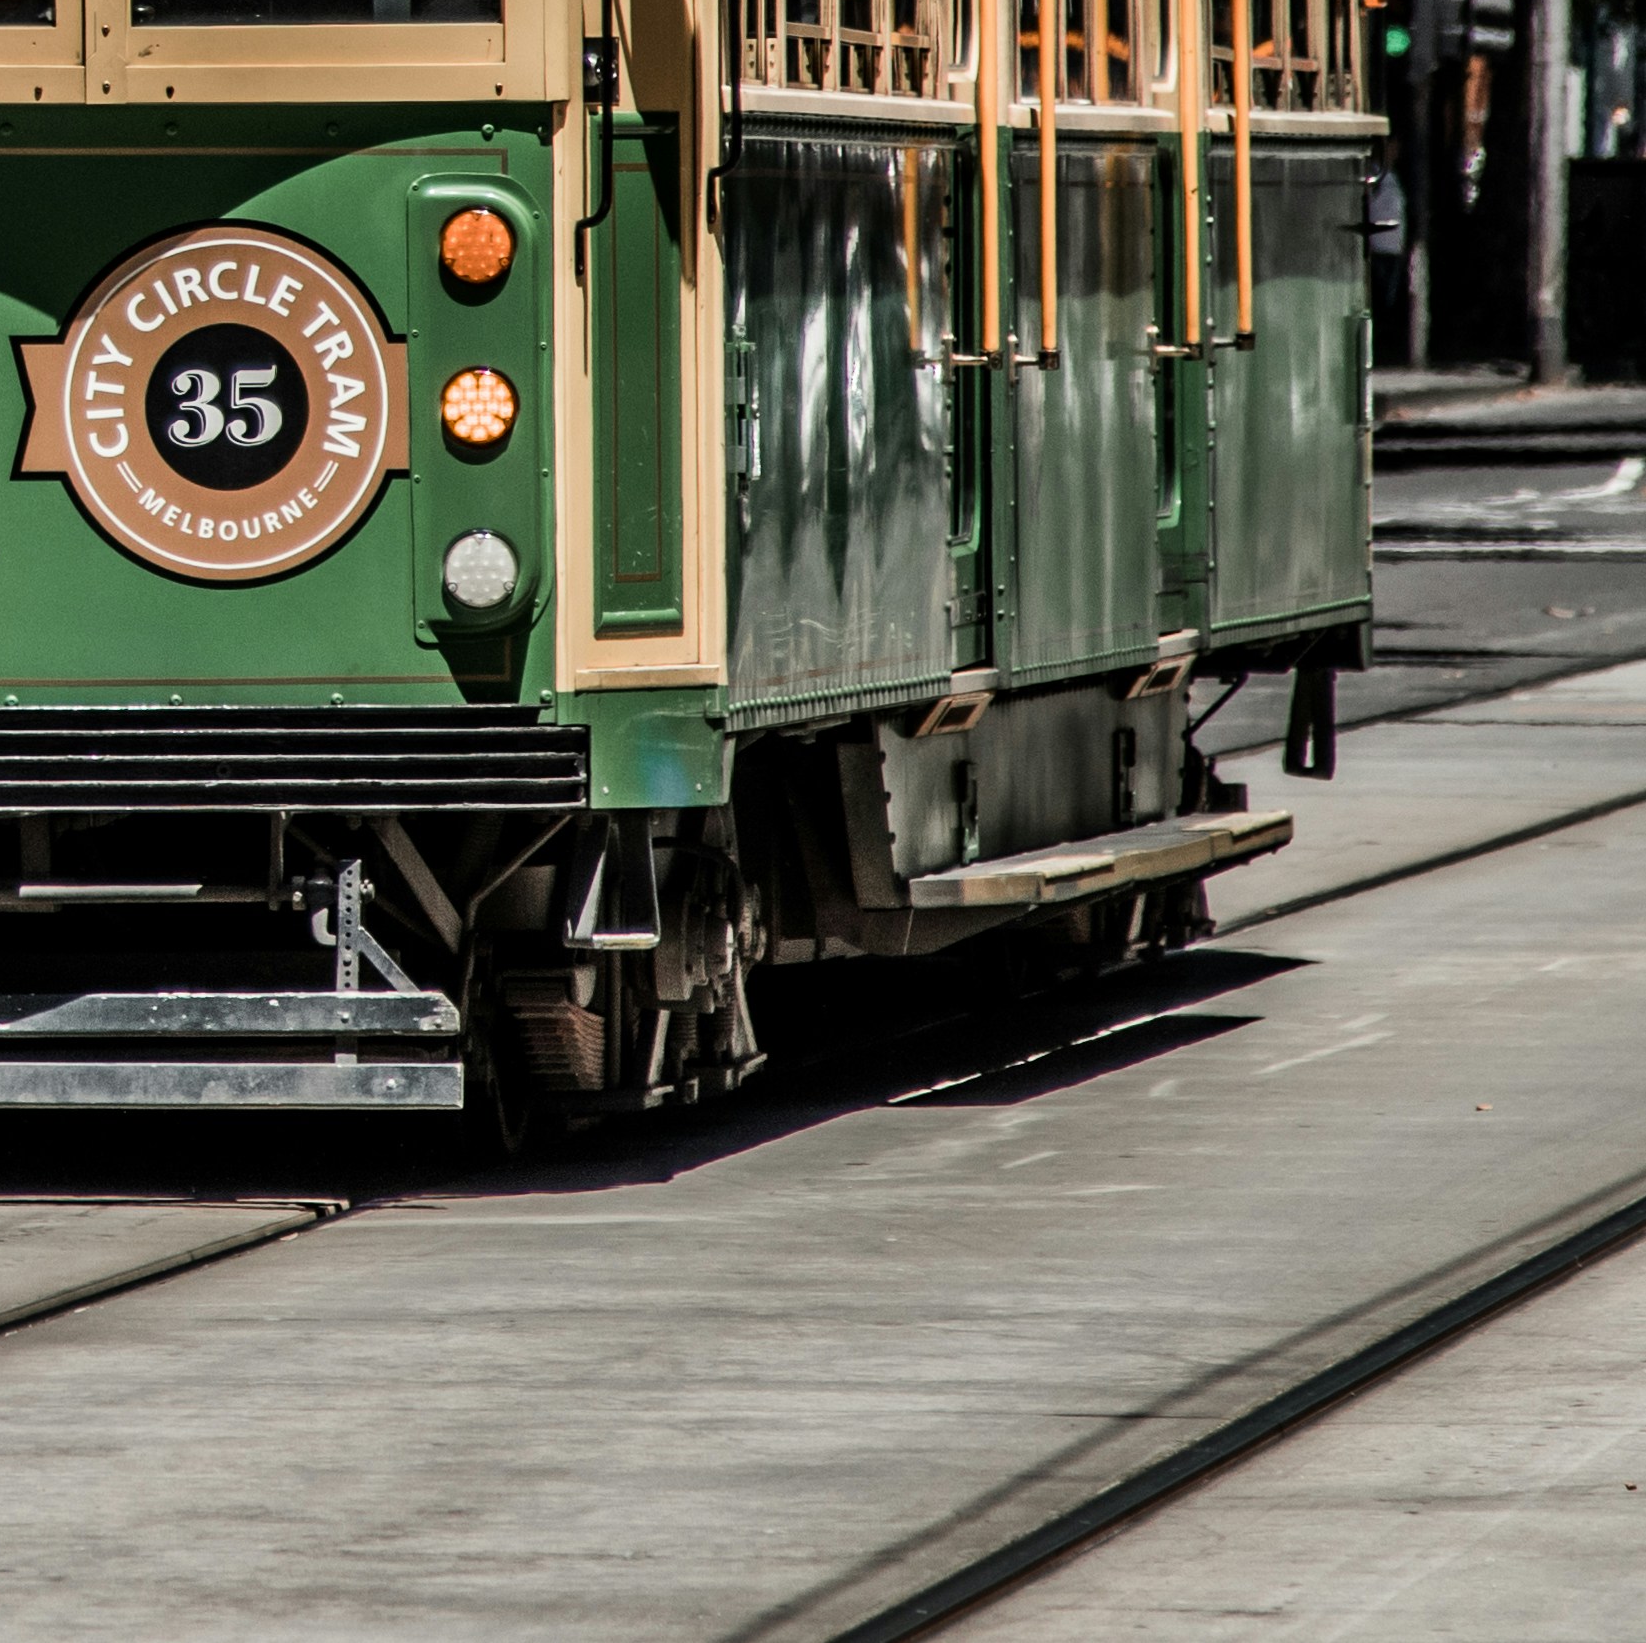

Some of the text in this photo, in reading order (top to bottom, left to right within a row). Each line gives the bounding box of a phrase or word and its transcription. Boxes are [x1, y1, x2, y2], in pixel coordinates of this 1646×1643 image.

[85, 260, 369, 459] CITY CIRCLE TRAM
[167, 363, 284, 448] 35
[137, 486, 319, 542] MELBOURNE
